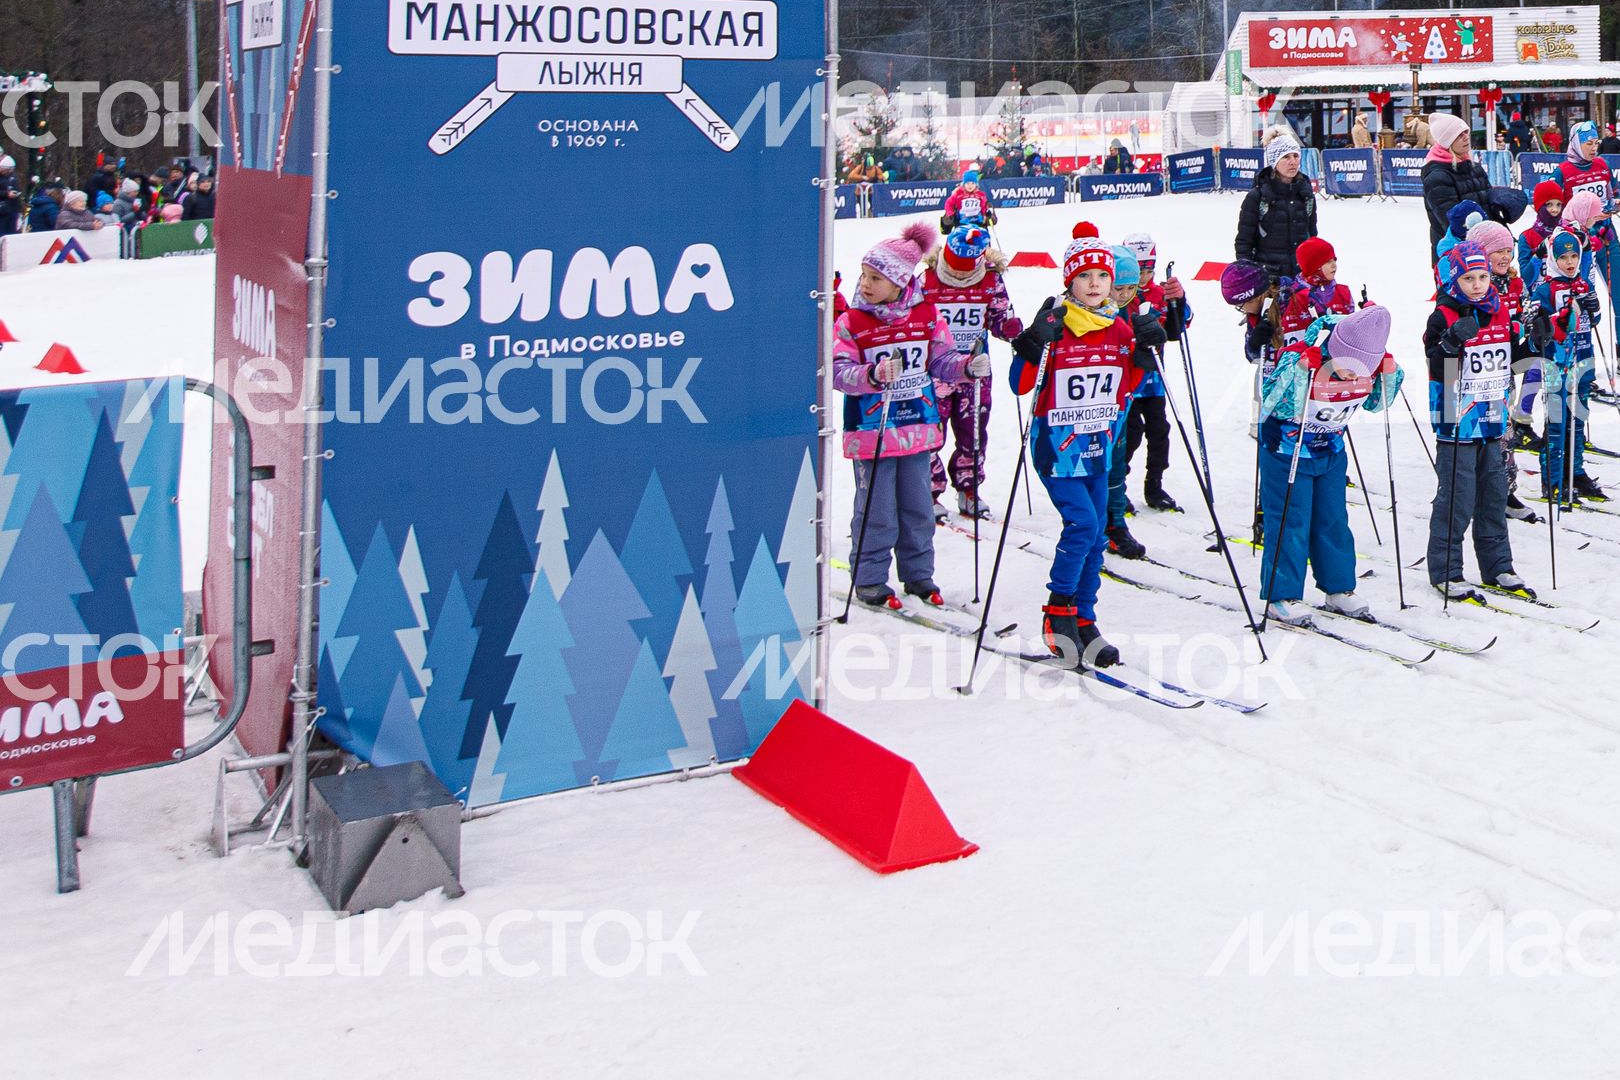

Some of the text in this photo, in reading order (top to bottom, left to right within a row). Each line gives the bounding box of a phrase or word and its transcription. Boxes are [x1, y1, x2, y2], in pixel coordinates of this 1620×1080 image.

[405, 1, 764, 48] МАНЖОСОВСКАЯ
[1268, 26, 1358, 50] ЗИМА
[1290, 51, 1344, 59] Подмосковье
[538, 61, 642, 86] ЛЫЖНЯ
[538, 119, 639, 133] ОСНОВАНА
[567, 134, 607, 148] 1969
[1175, 155, 1205, 169] УРАЛХИМ
[1224, 158, 1259, 170] УРАЛХИМ
[1329, 160, 1367, 172] УРАЛХИМ
[1532, 162, 1560, 173] УРАЛ
[890, 187, 947, 200] УРАЛХИМ
[990, 186, 1056, 199] УРАЛХИМ
[1091, 182, 1151, 195] УРАЛХИМ
[406, 242, 735, 327] ЗИМА
[232, 273, 277, 361] ЗИМА
[460, 330, 686, 360] в Подмосковье
[1470, 347, 1508, 374] 632
[1067, 372, 1113, 401] 674
